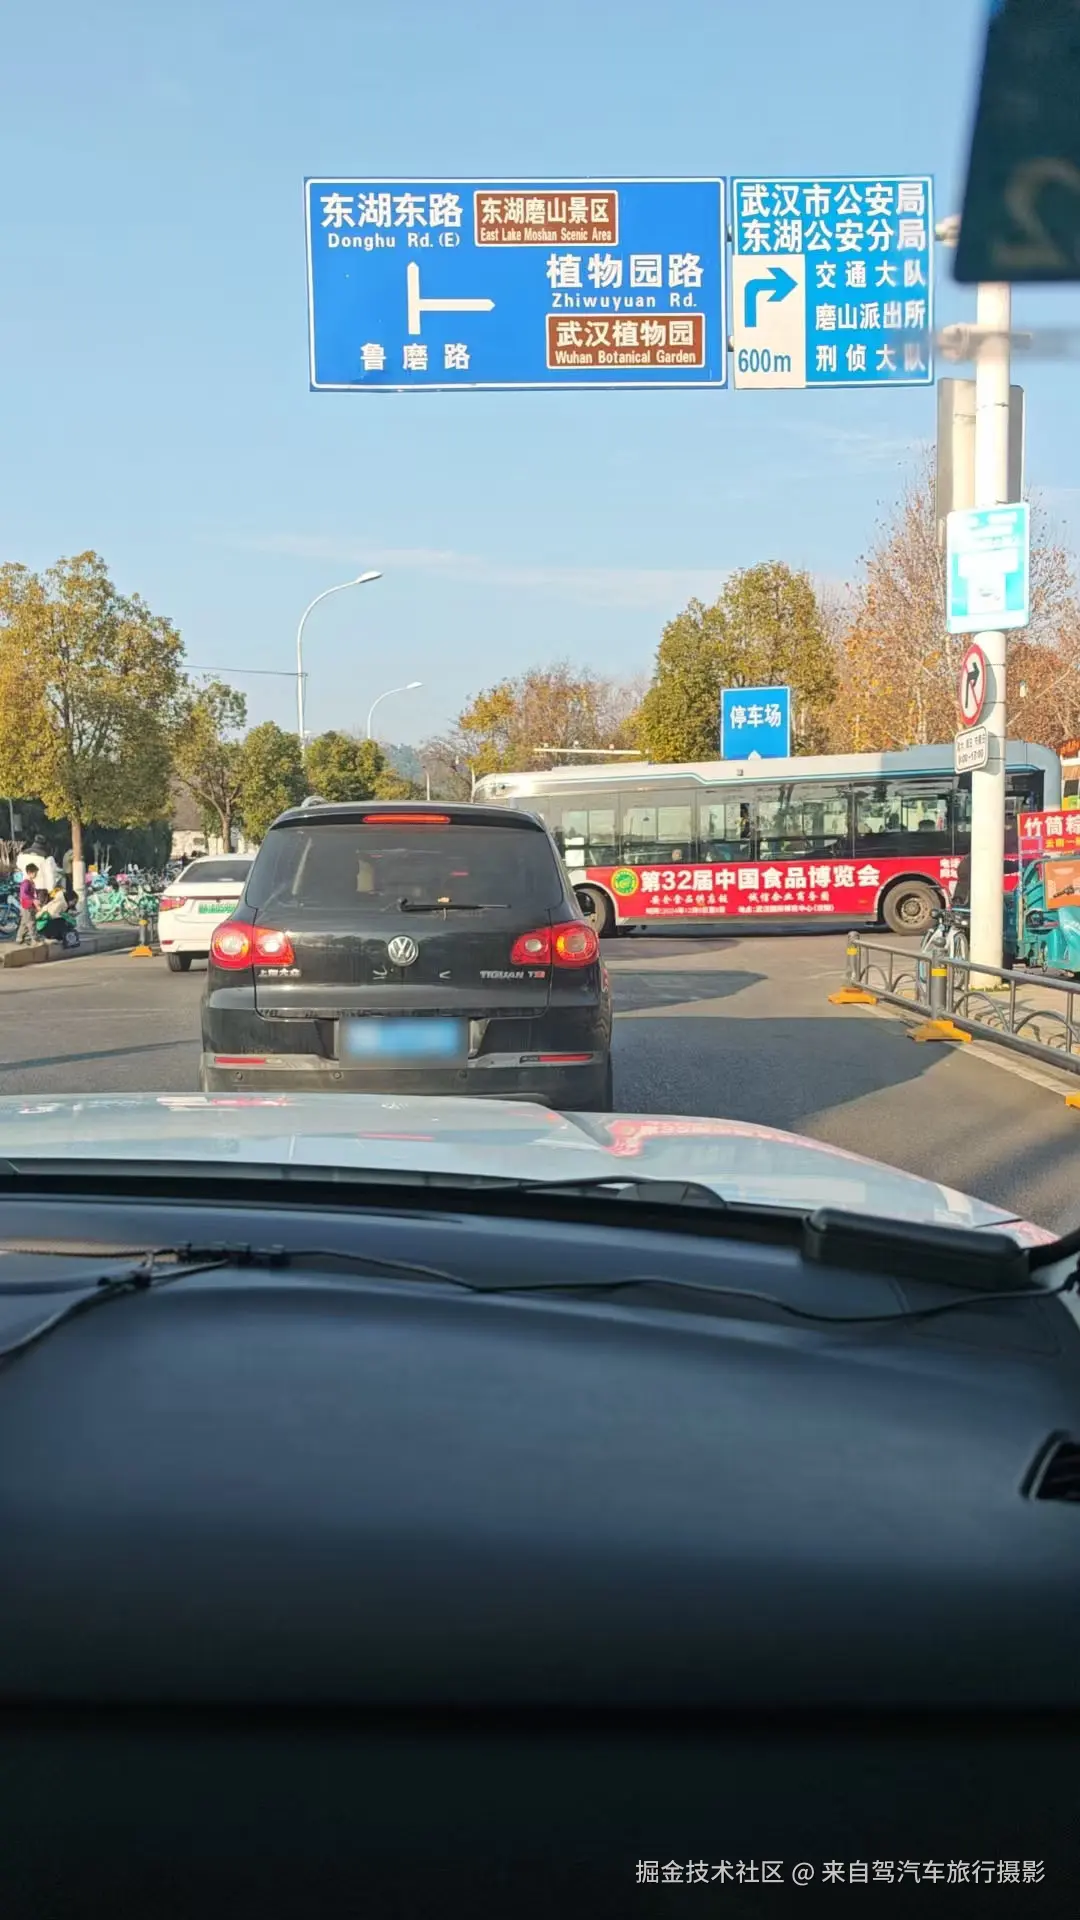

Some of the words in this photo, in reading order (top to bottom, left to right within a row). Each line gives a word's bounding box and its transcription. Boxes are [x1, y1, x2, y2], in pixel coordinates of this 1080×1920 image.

[320, 192, 463, 228] 东湖东路
[480, 197, 609, 224] 东湖磨山景区
[740, 183, 925, 217] 武汉市公安局
[328, 233, 396, 250] Donghu
[407, 233, 434, 248] Rd.
[438, 233, 460, 248] (E)
[480, 226, 499, 241] East
[502, 227, 522, 241] Lake
[524, 227, 557, 241] Moshan
[560, 227, 589, 241] Scenic
[592, 228, 612, 241] Area
[741, 218, 926, 252] 东湖公安分局
[546, 253, 704, 288] 植物园路
[816, 260, 926, 289] 交通大队
[552, 293, 657, 311] Zhiwuyuan
[670, 293, 697, 308] Rd.
[815, 301, 926, 331] 磨山派出所
[556, 321, 694, 347] 武汉植物园
[360, 343, 471, 371] 鲁磨路
[555, 350, 593, 365] Wuhan
[598, 349, 651, 365] Botanical
[656, 349, 696, 365] Garden
[738, 349, 792, 373] 600m
[815, 344, 926, 372] 刑侦大队
[730, 703, 782, 729] 停车场
[640, 864, 881, 893] 第32届中国食品博览会
[480, 970, 524, 979] TIGUAN
